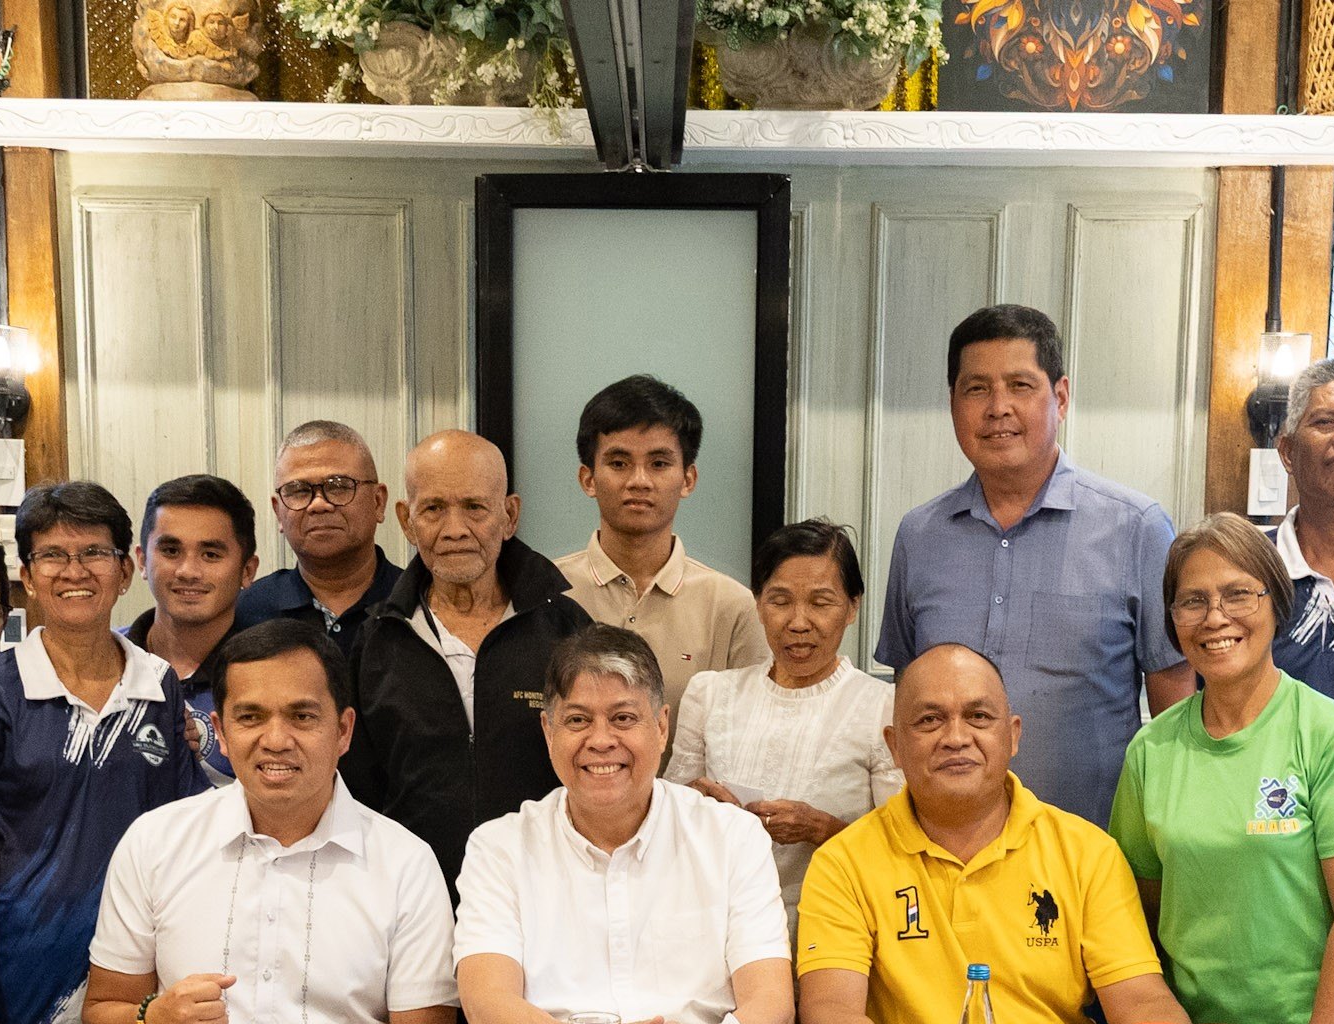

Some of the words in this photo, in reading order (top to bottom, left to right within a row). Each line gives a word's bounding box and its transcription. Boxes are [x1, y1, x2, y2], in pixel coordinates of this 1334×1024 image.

[524, 691, 544, 700] MONITO
[895, 885, 929, 941] 1
[1026, 937, 1059, 948] USPA
